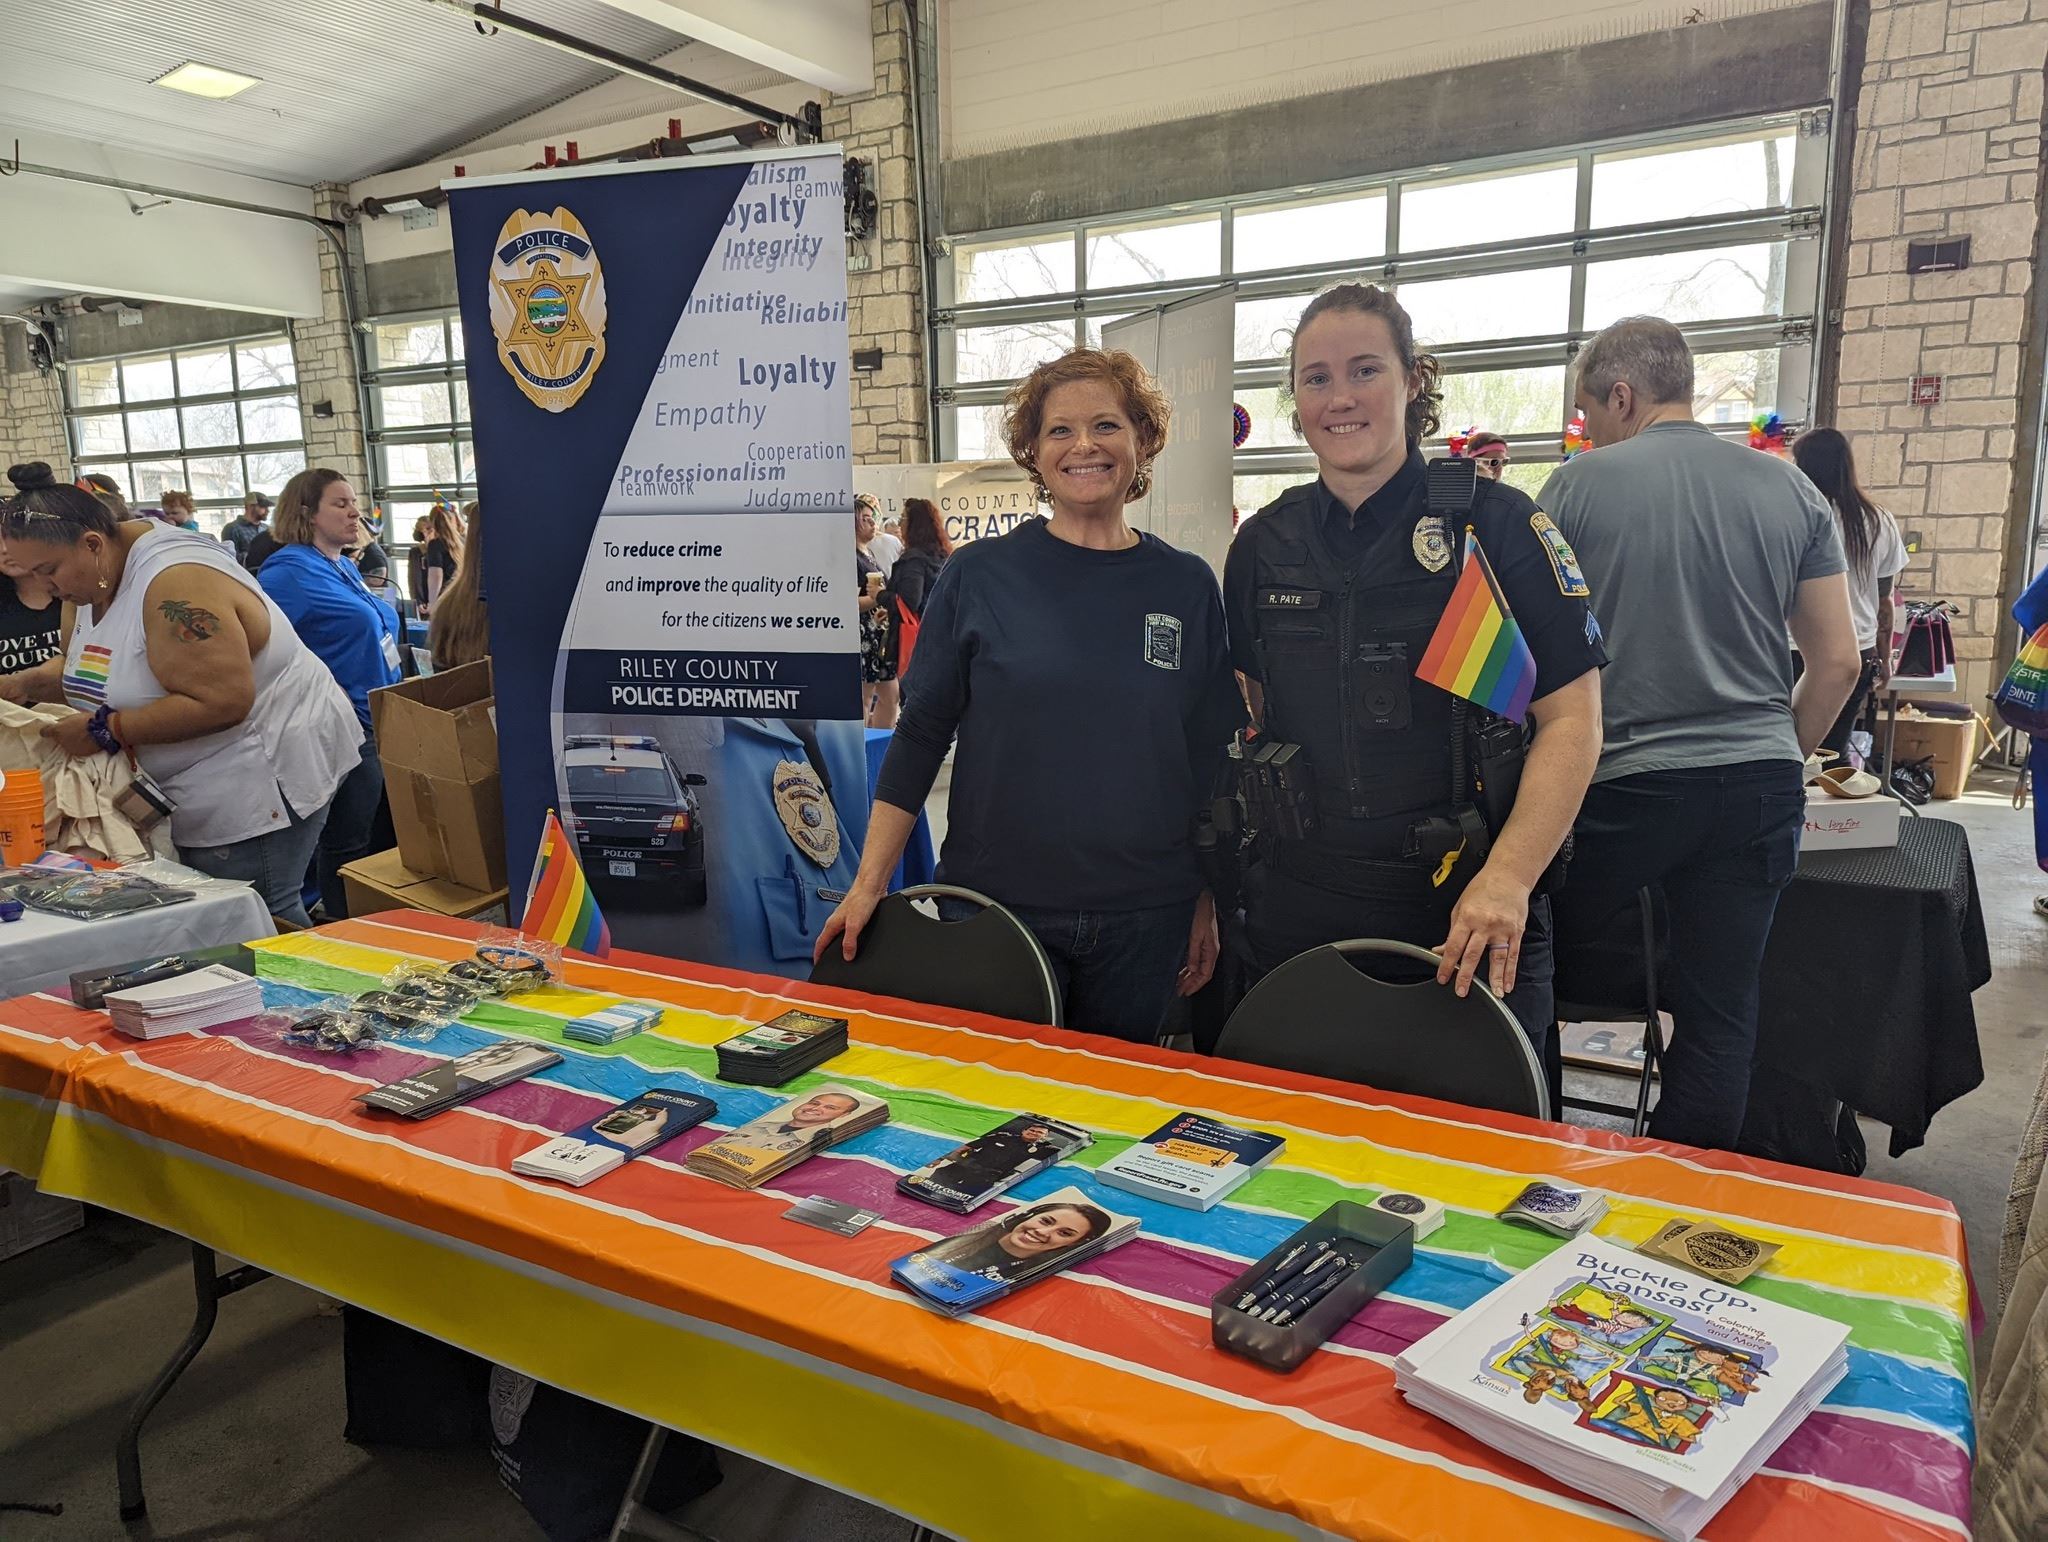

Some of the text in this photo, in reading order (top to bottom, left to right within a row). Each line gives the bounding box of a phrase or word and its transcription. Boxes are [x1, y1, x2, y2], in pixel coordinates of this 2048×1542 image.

[747, 163, 806, 186] alism
[516, 233, 569, 251] POLICE
[726, 233, 823, 260] Integrity
[722, 247, 817, 273] Integrity
[688, 290, 786, 314] Initiative
[527, 370, 582, 388] RILEY COUNTY
[738, 354, 836, 392] Loyalty
[655, 398, 767, 431] Empathy
[747, 442, 846, 465] Cooperation
[621, 461, 786, 483] Professionalism
[618, 477, 694, 497] Teamwork
[744, 487, 846, 511] Judgment
[941, 492, 1036, 511] COUNTY
[603, 541, 723, 558] To reduce crime
[605, 576, 829, 597] and improve the quality of life
[1269, 594, 1302, 605] R. PATE
[661, 611, 845, 629] for the citizens we serve.
[620, 658, 779, 680] RILEY COUNTY
[1153, 658, 1173, 668] POLICE
[612, 686, 801, 710] POLICE DEPARTMENT
[603, 849, 643, 859] POLICE
[551, 1148, 587, 1161] CAM
[942, 1187, 975, 1201] COUNTY
[1576, 1253, 1689, 1292] Buckle
[1586, 1271, 1715, 1315] Kansas!
[1705, 1319, 1772, 1345] Fun Puzzles
[1718, 1316, 1767, 1337] Coloring,
[1707, 1328, 1766, 1351] and More
[1472, 1374, 1509, 1394] Kansas
